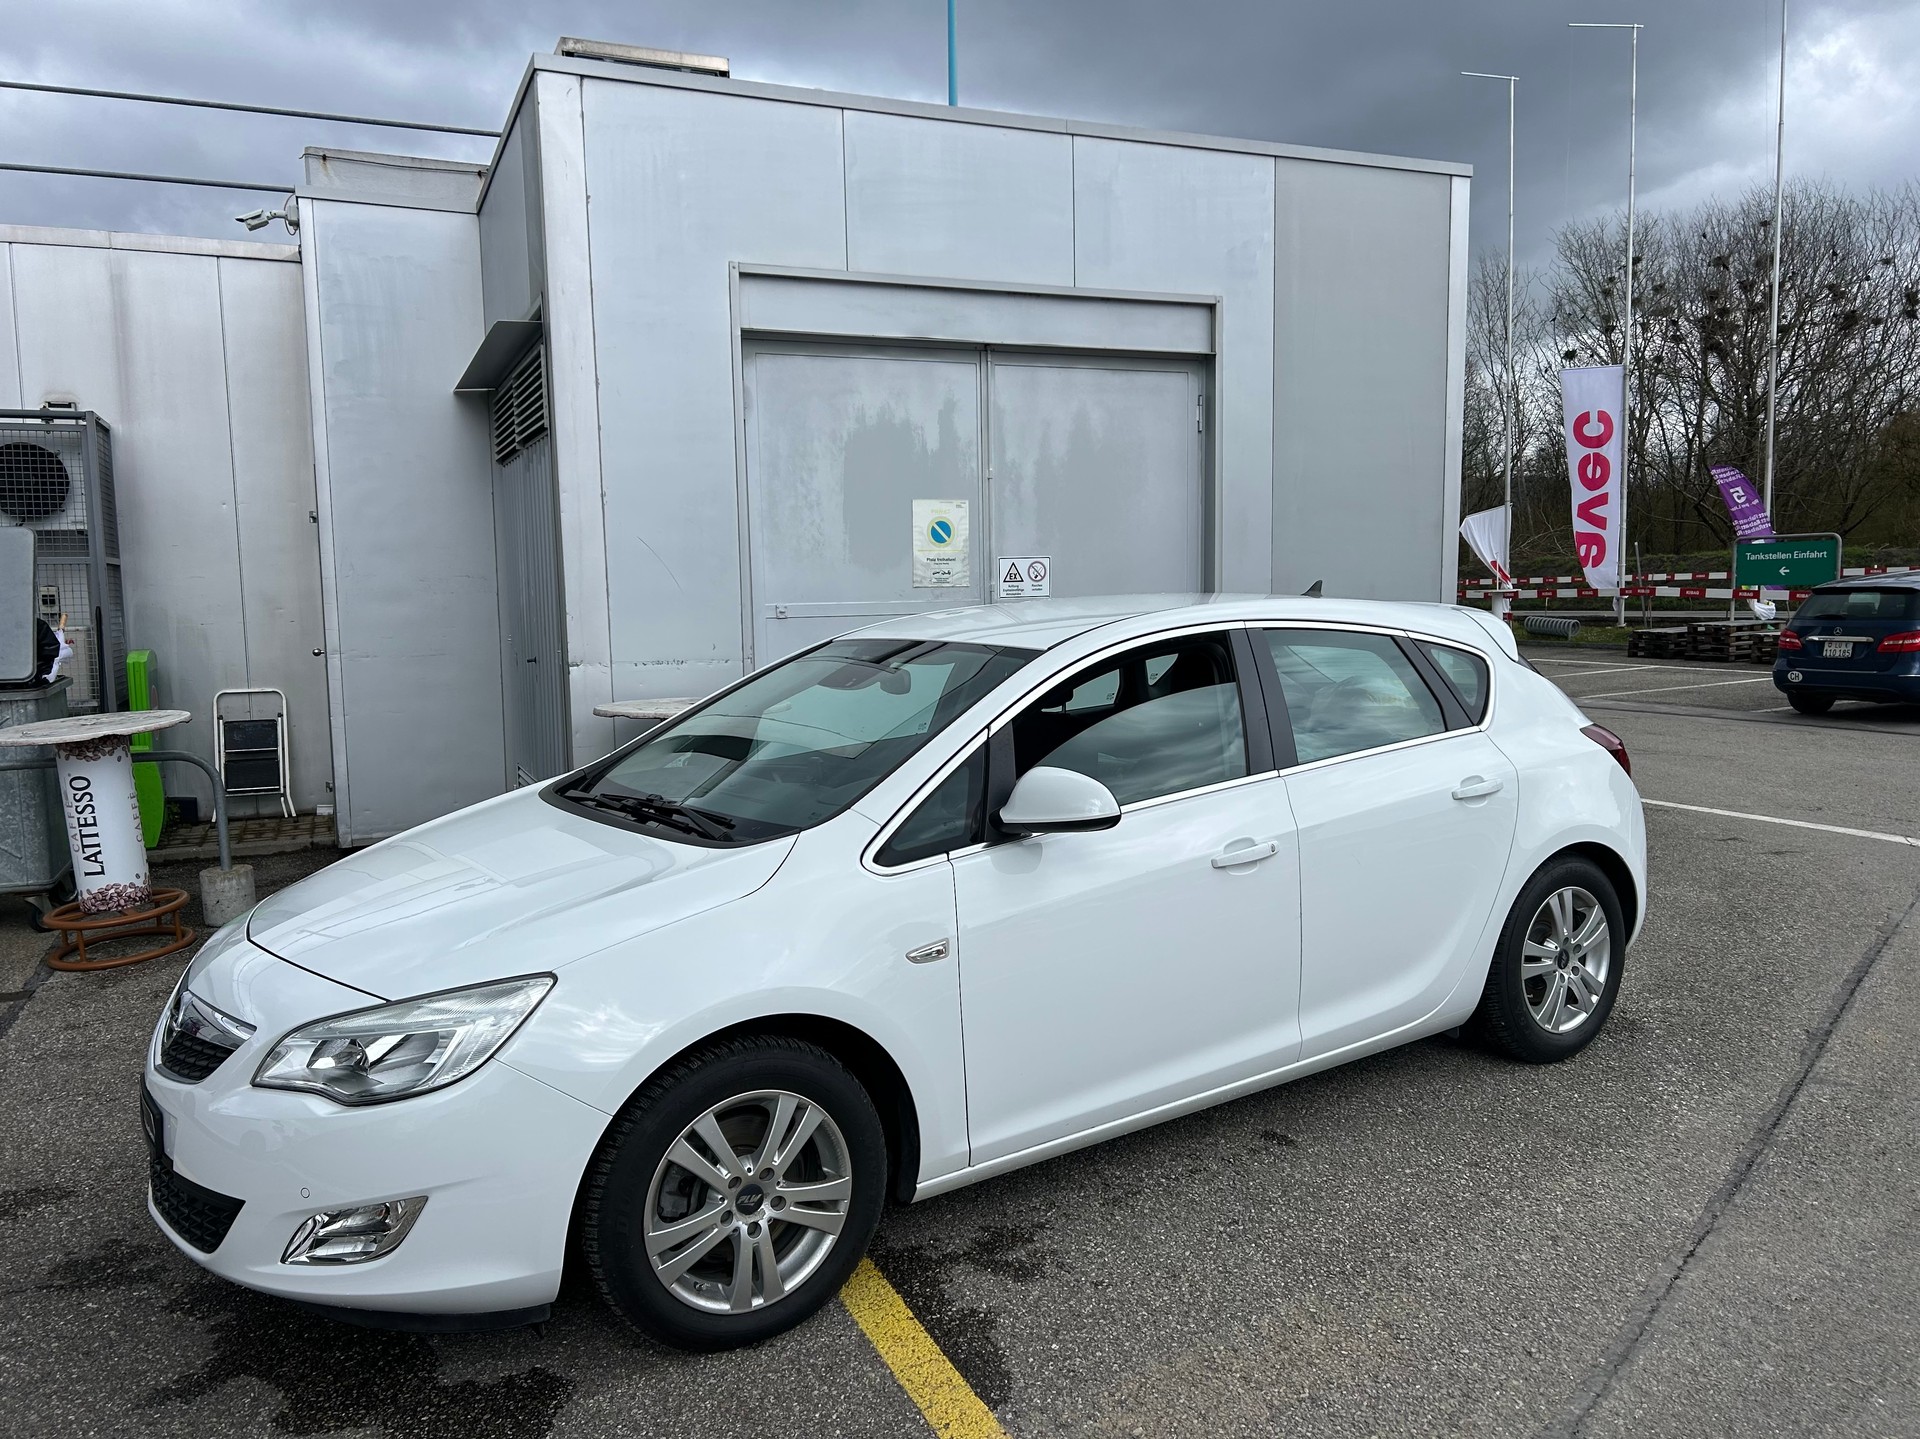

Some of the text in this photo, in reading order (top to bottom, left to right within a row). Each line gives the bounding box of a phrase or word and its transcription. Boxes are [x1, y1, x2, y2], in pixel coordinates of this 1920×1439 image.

[1745, 550, 1828, 560] Tankstellen Einfahrt
[1790, 672, 1800, 681] CH
[69, 775, 106, 878] LATTESSO
